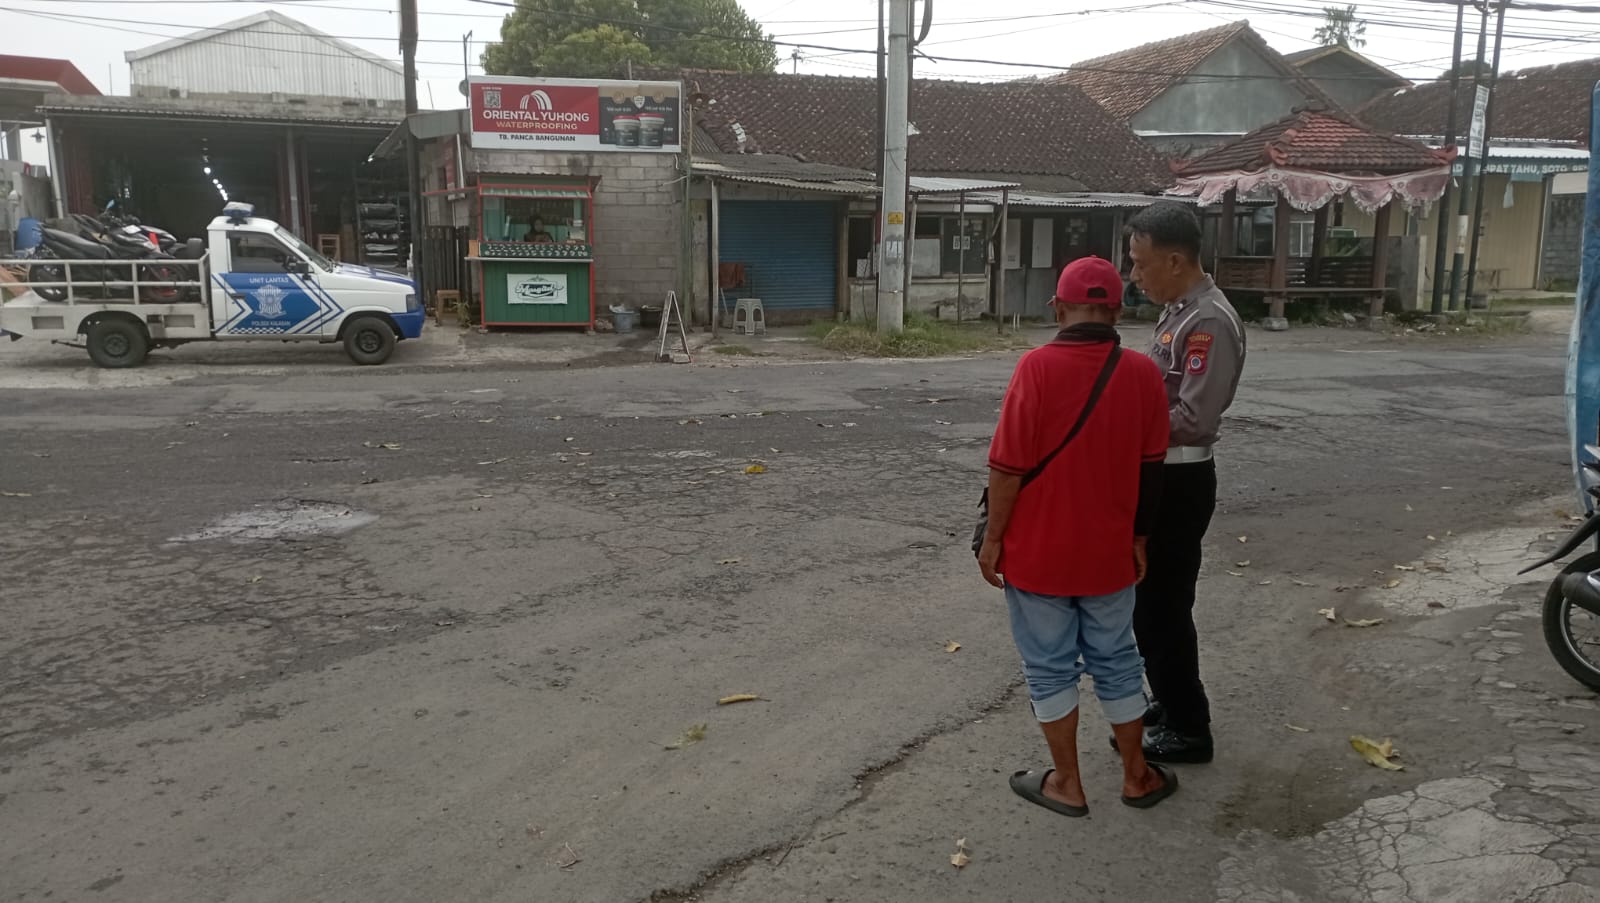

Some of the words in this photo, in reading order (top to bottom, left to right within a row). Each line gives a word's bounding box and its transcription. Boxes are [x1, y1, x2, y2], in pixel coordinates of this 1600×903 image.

[483, 110, 540, 121] ORIENTAL
[540, 111, 589, 122] YUHONG
[496, 121, 578, 130] WATERPROOFING
[1511, 164, 1540, 175] TAHU,
